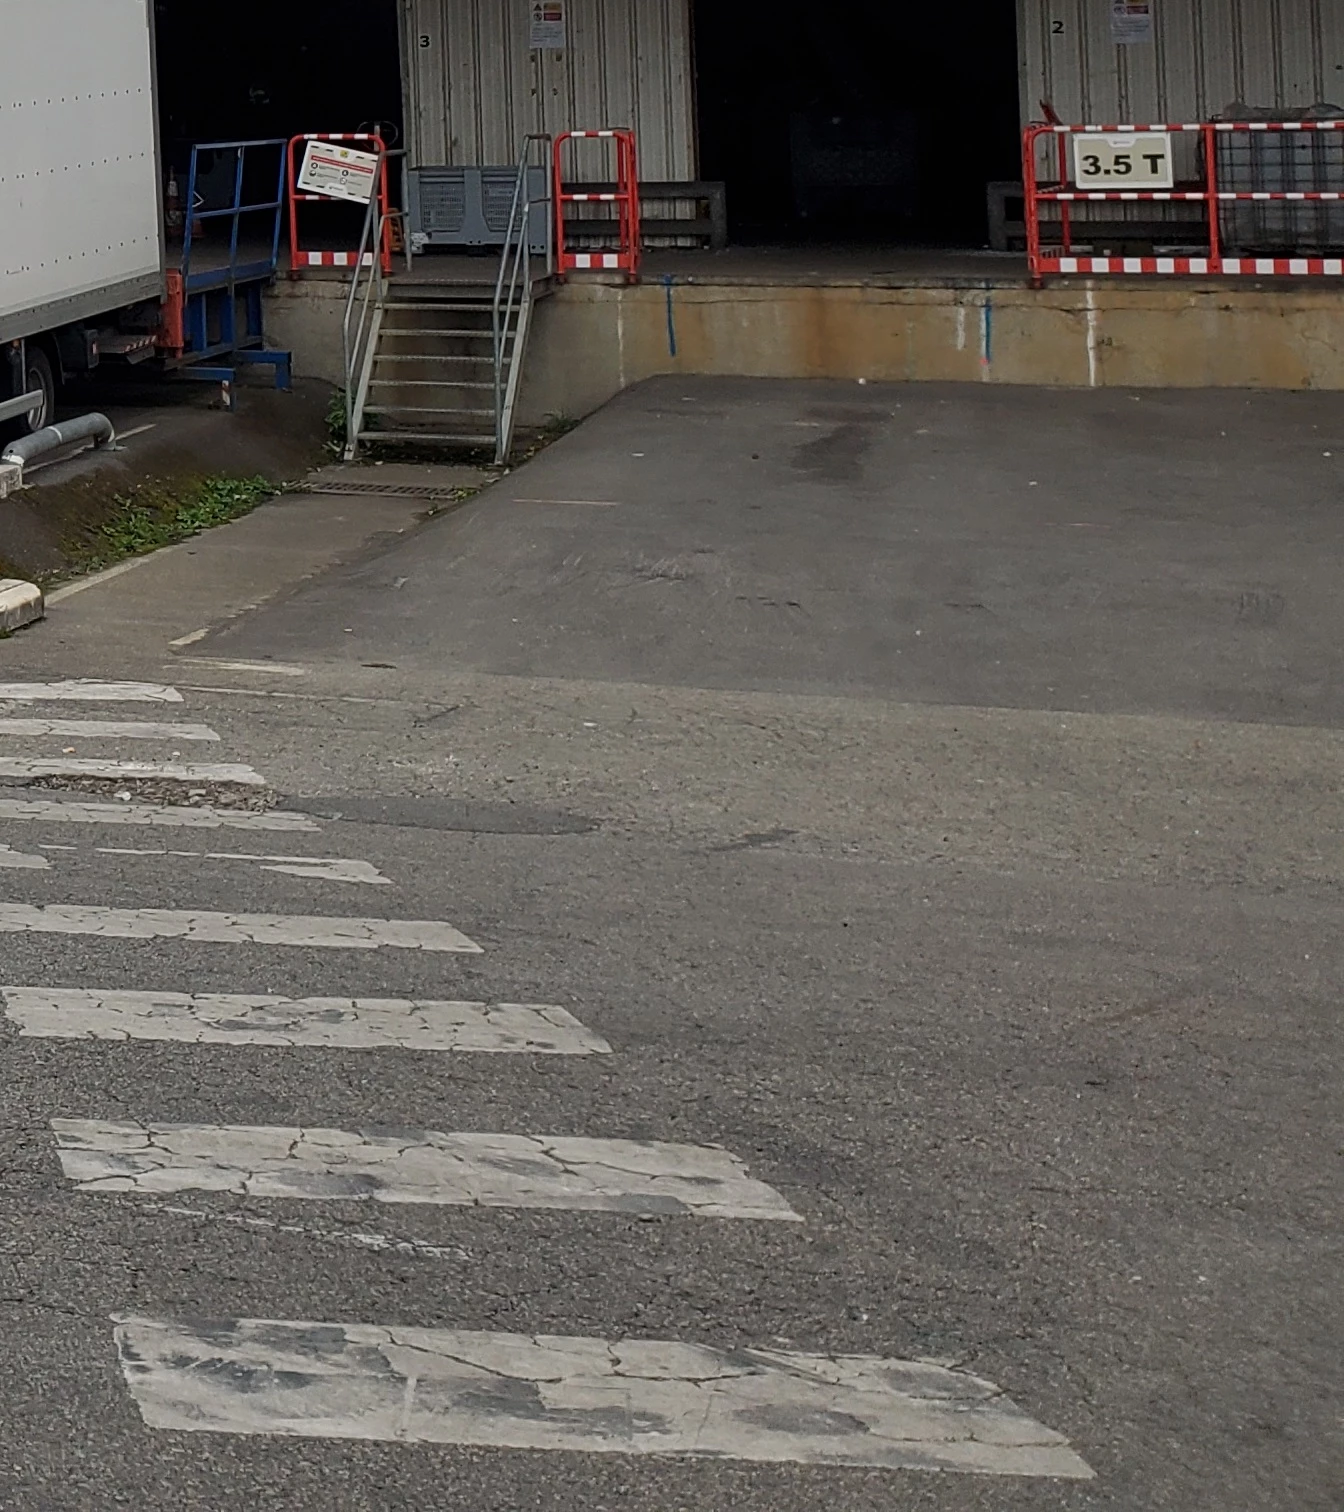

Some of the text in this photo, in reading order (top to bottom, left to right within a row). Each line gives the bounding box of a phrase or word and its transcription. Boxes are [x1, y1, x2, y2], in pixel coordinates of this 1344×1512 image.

[1052, 20, 1065, 34] 2
[419, 35, 430, 48] 3
[1081, 153, 1165, 176] 3.5 T
